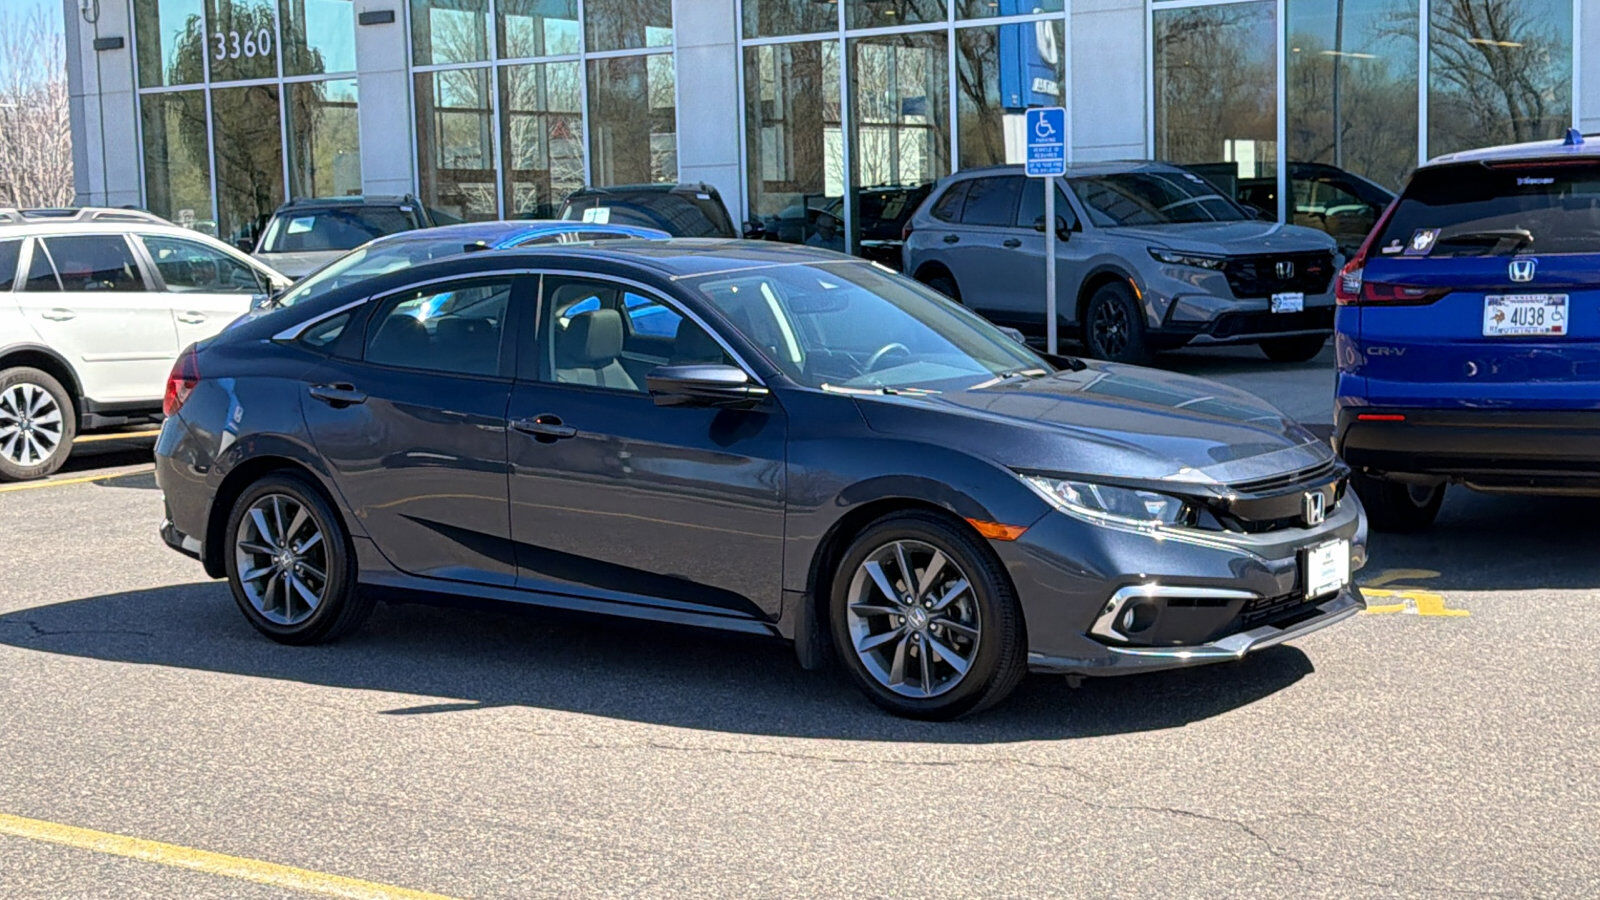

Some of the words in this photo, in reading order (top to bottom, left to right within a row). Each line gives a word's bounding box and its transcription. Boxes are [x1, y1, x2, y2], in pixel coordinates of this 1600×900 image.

[214, 28, 272, 60] 3360
[1510, 306, 1545, 326] 4U38
[1366, 346, 1406, 356] CR-V
